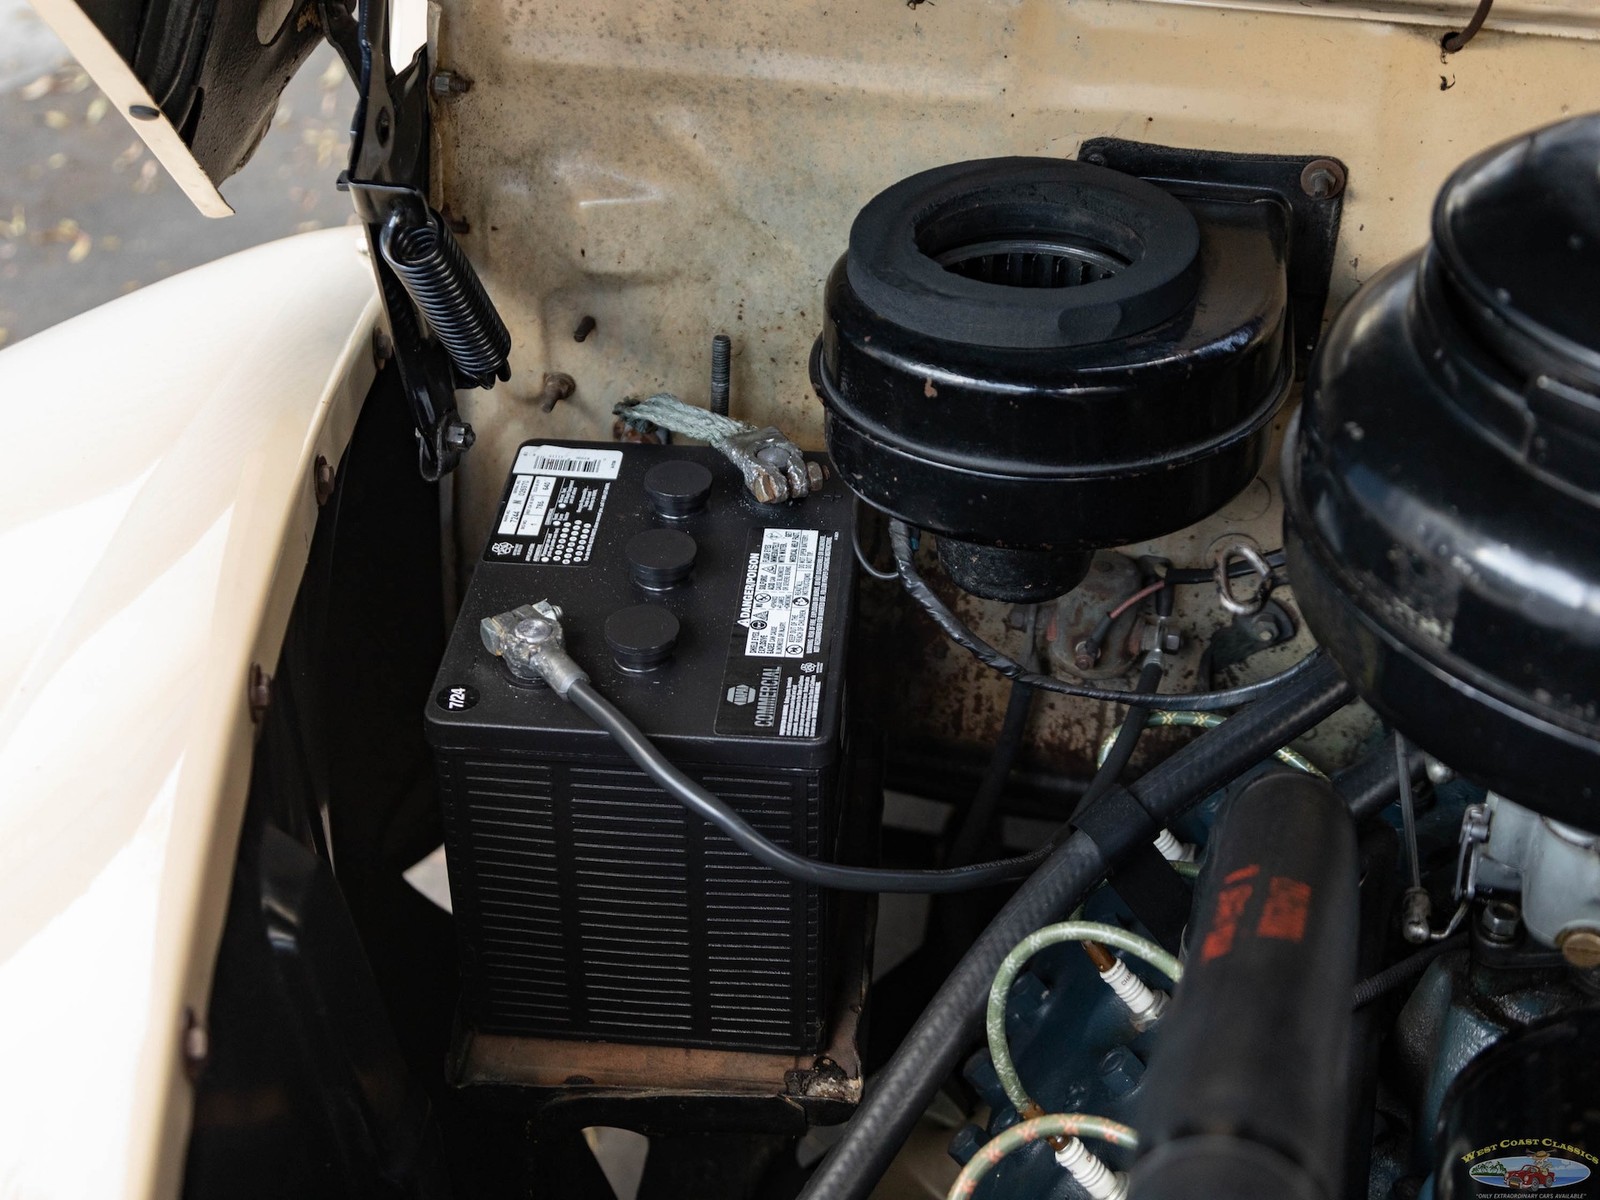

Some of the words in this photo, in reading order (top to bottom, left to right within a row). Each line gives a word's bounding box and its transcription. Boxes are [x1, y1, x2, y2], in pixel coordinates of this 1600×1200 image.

[740, 553, 760, 618] DANGER/POISON
[448, 687, 467, 709] 7/24
[754, 666, 780, 727] COMMERCIAL
